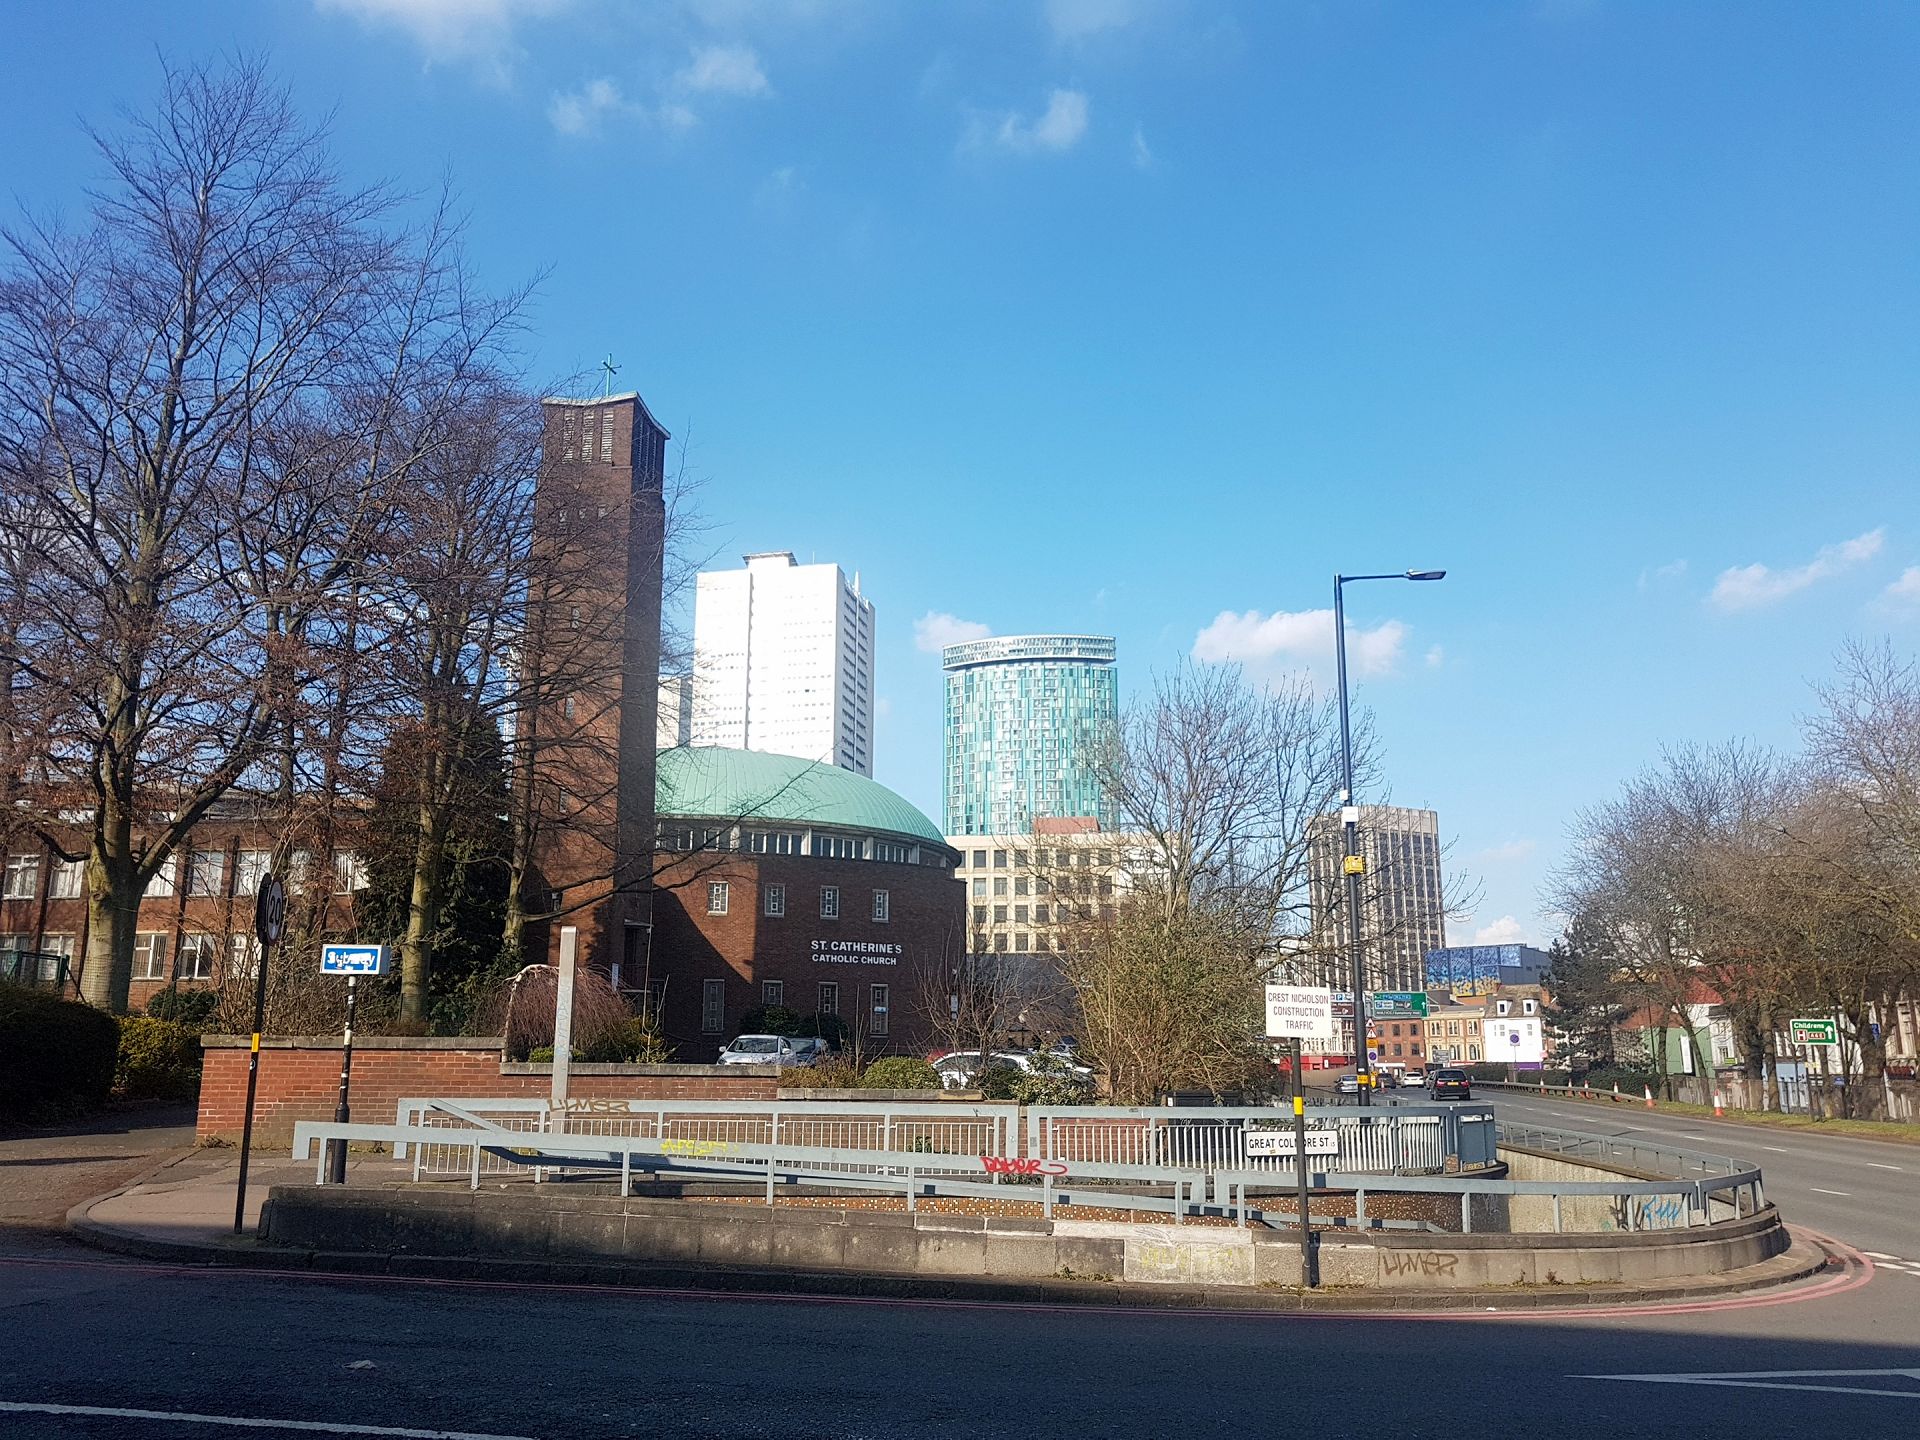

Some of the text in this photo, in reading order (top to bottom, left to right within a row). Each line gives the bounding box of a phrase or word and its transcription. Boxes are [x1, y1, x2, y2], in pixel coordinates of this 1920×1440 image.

[269, 895, 280, 925] 20
[811, 940, 902, 954] ST. CATHERINE'S
[812, 954, 897, 966] CATHOLIC CHURCH
[1268, 992, 1329, 1004] CREST NICHOLSON
[1273, 1006, 1325, 1018] CONSTRUCTION
[1286, 1020, 1314, 1031] TRAFFIC
[1249, 1138, 1276, 1149] GREAT
[1278, 1137, 1317, 1149] COLRE
[1319, 1137, 1329, 1147] ST
